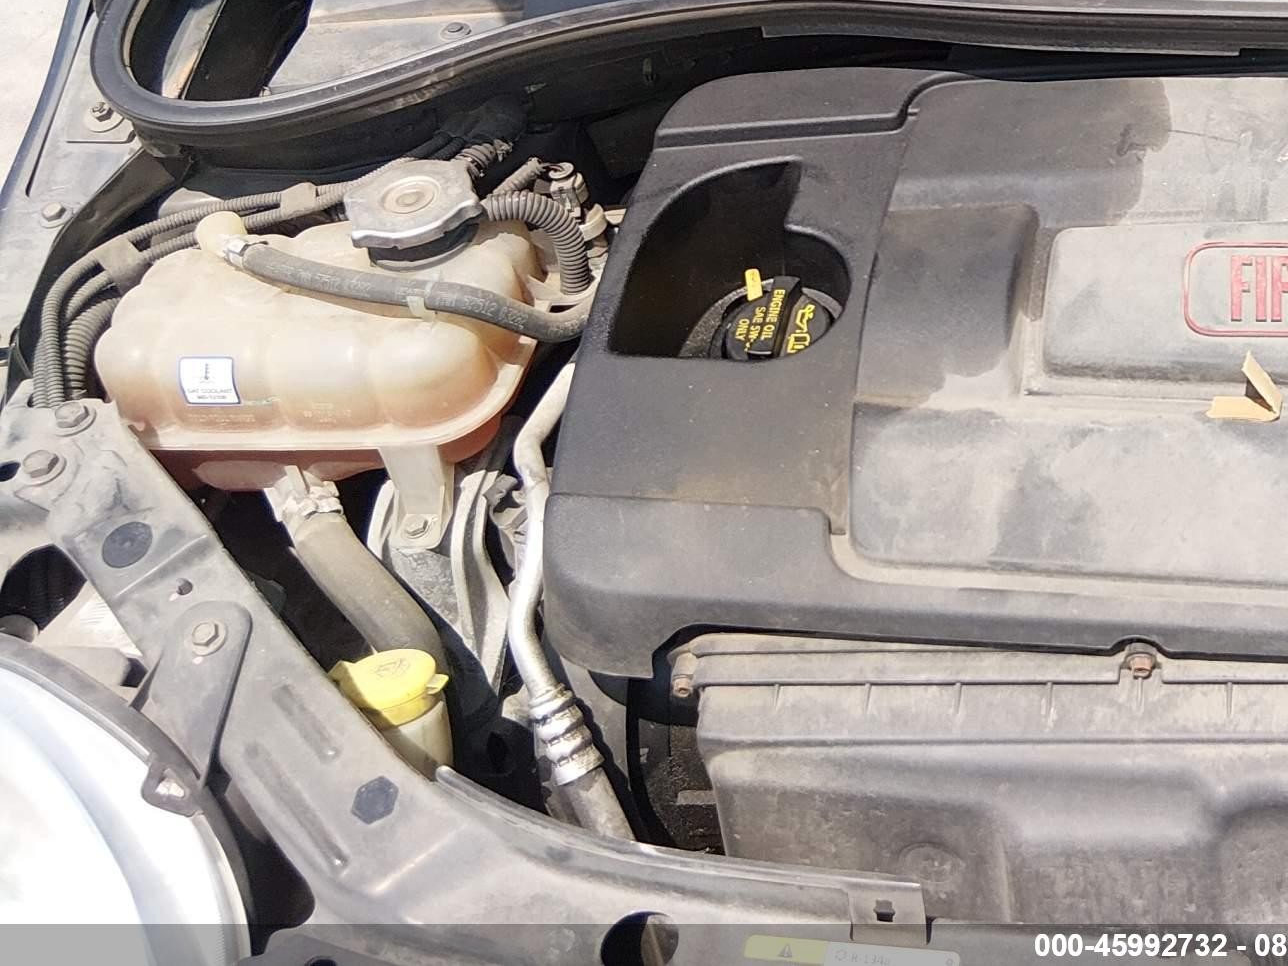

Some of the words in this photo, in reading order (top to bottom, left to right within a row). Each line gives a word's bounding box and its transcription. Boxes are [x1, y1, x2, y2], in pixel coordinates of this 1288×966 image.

[753, 306, 766, 323] SAE
[765, 288, 786, 323] ENGINE
[735, 318, 751, 341] ONLY
[760, 323, 775, 341] OIL
